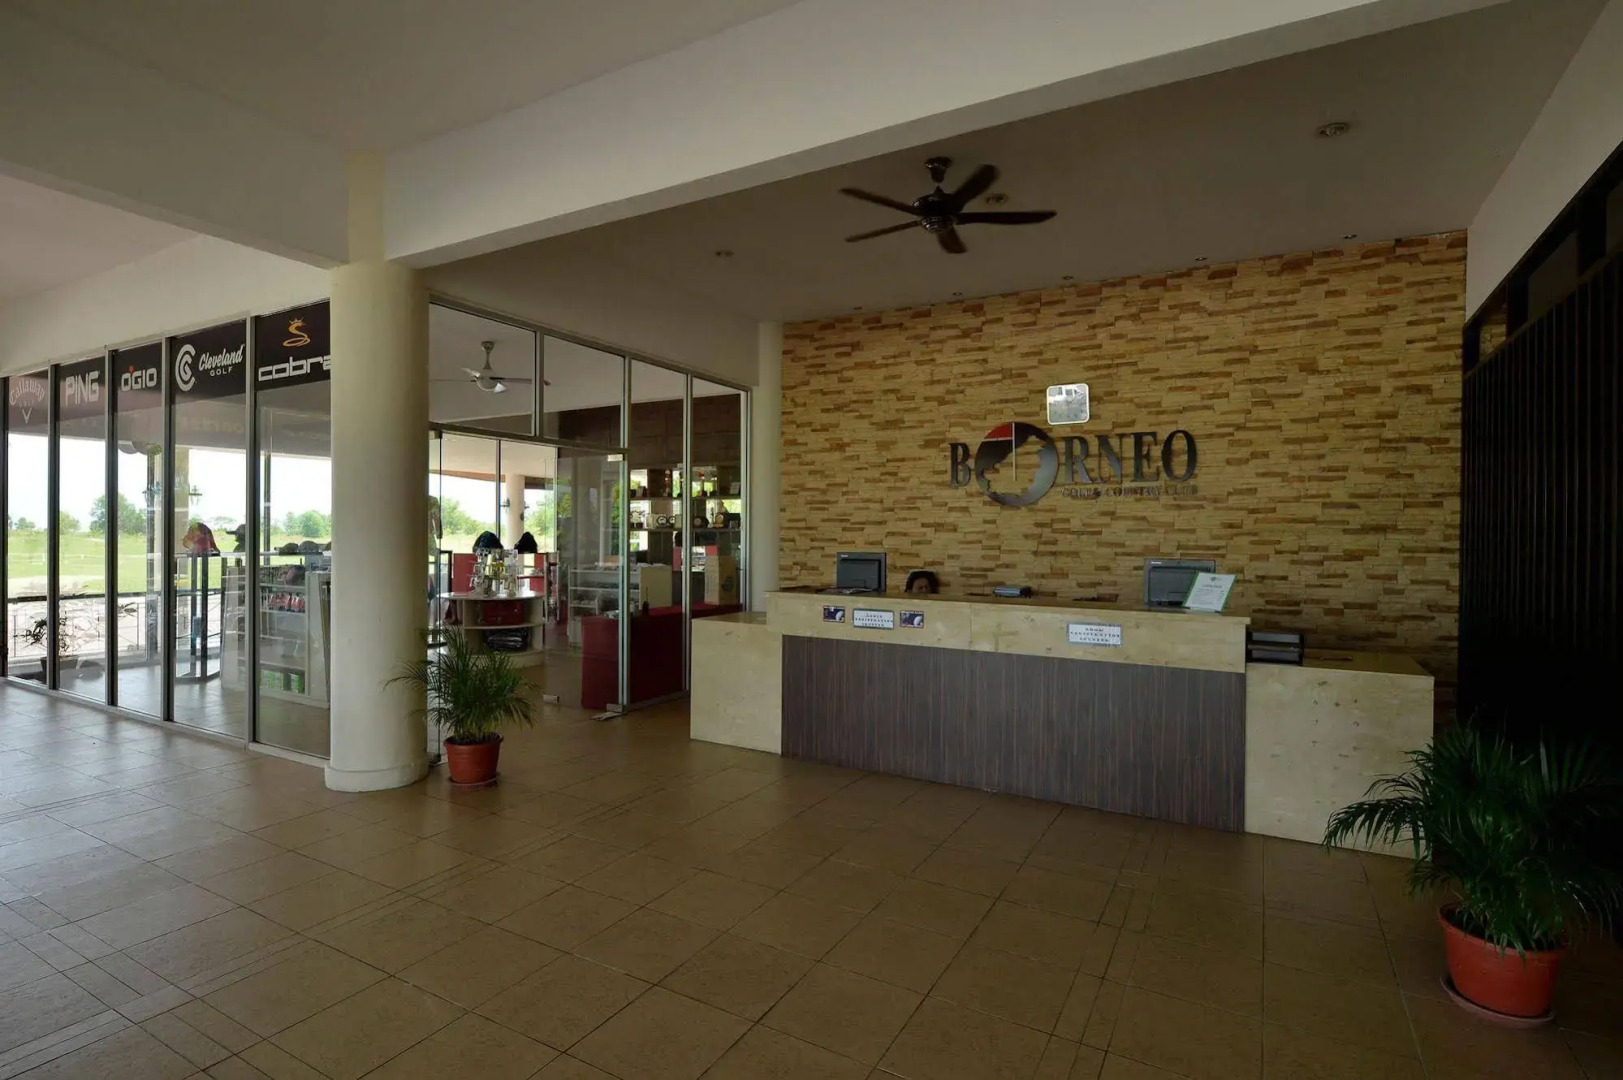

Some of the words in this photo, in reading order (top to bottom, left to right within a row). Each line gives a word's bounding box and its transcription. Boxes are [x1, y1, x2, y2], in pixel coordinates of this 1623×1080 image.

[198, 344, 244, 372] Cleveland
[209, 366, 234, 377] GOLF
[9, 379, 46, 406] Callaway
[65, 370, 100, 407] PING
[121, 366, 158, 392] OGIO
